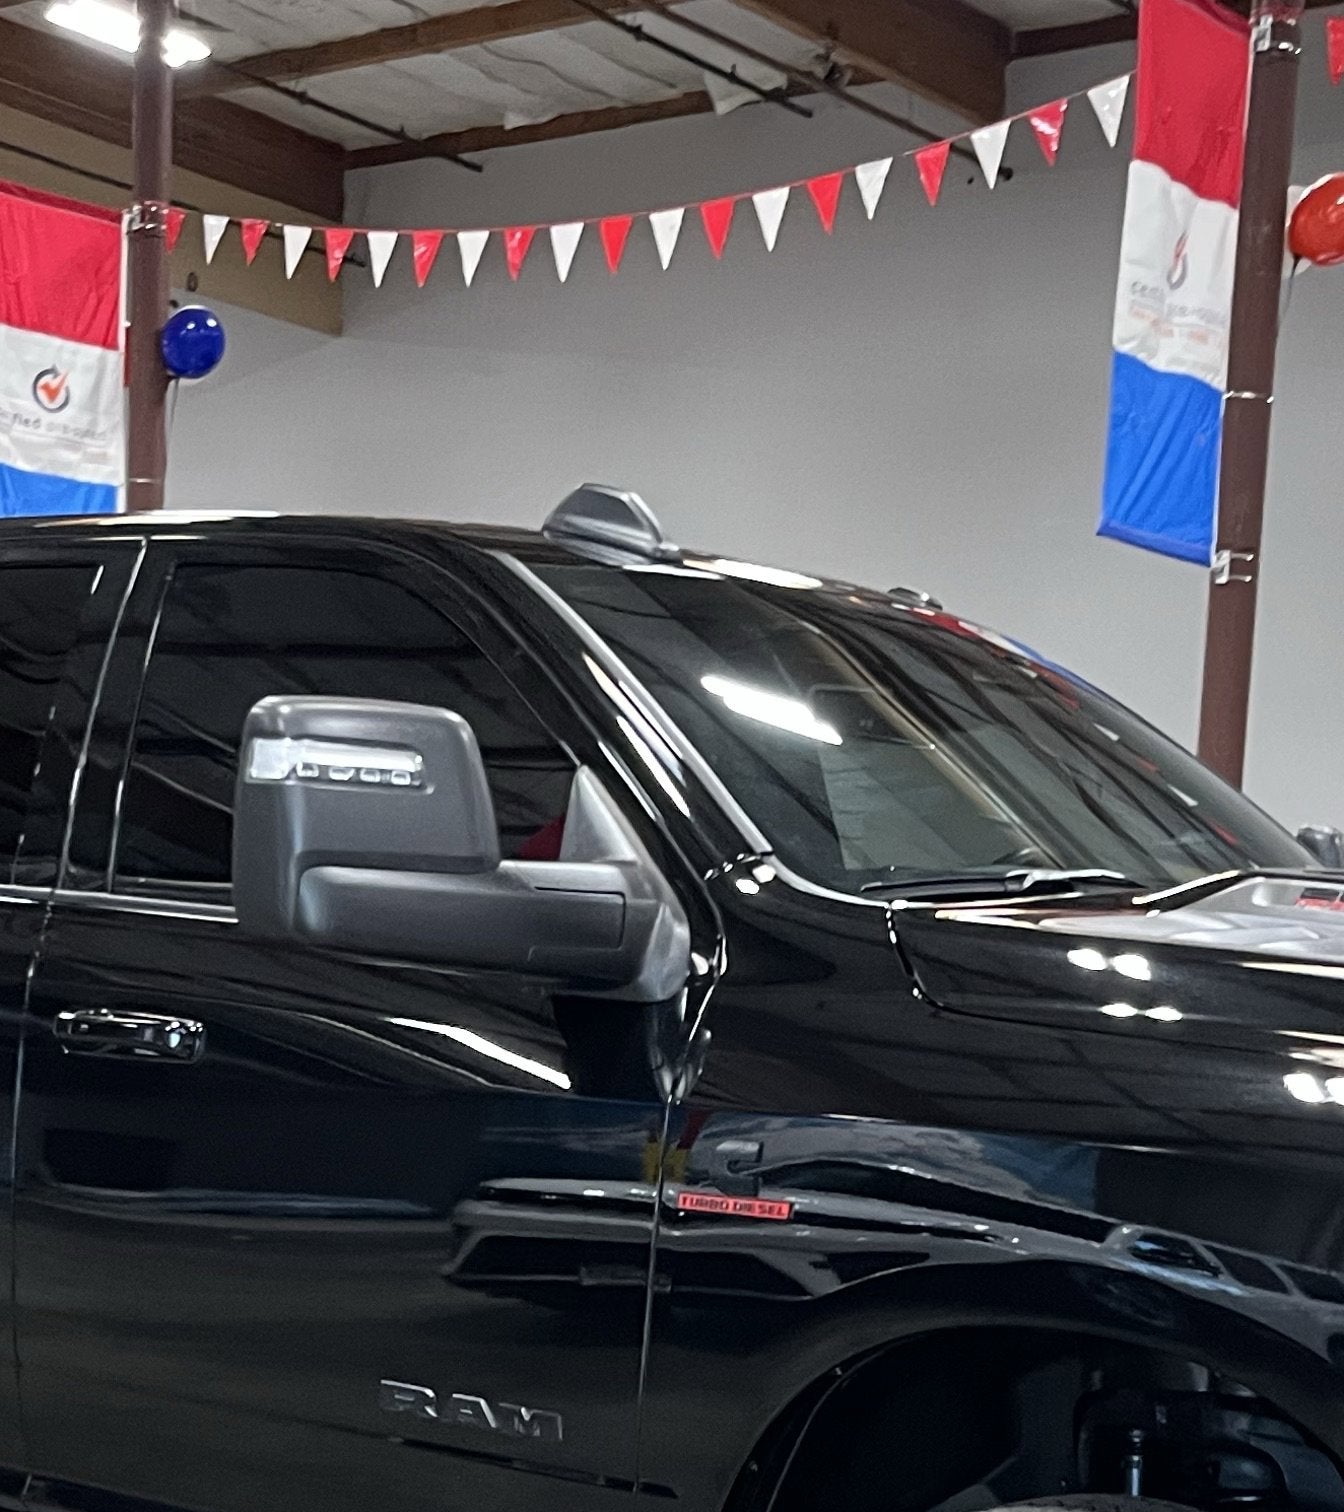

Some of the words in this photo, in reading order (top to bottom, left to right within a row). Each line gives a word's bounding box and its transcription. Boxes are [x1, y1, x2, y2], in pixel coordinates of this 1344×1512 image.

[681, 1196, 730, 1211] TURBO
[731, 1201, 786, 1216] DIESEL
[379, 1379, 563, 1441] RAM
